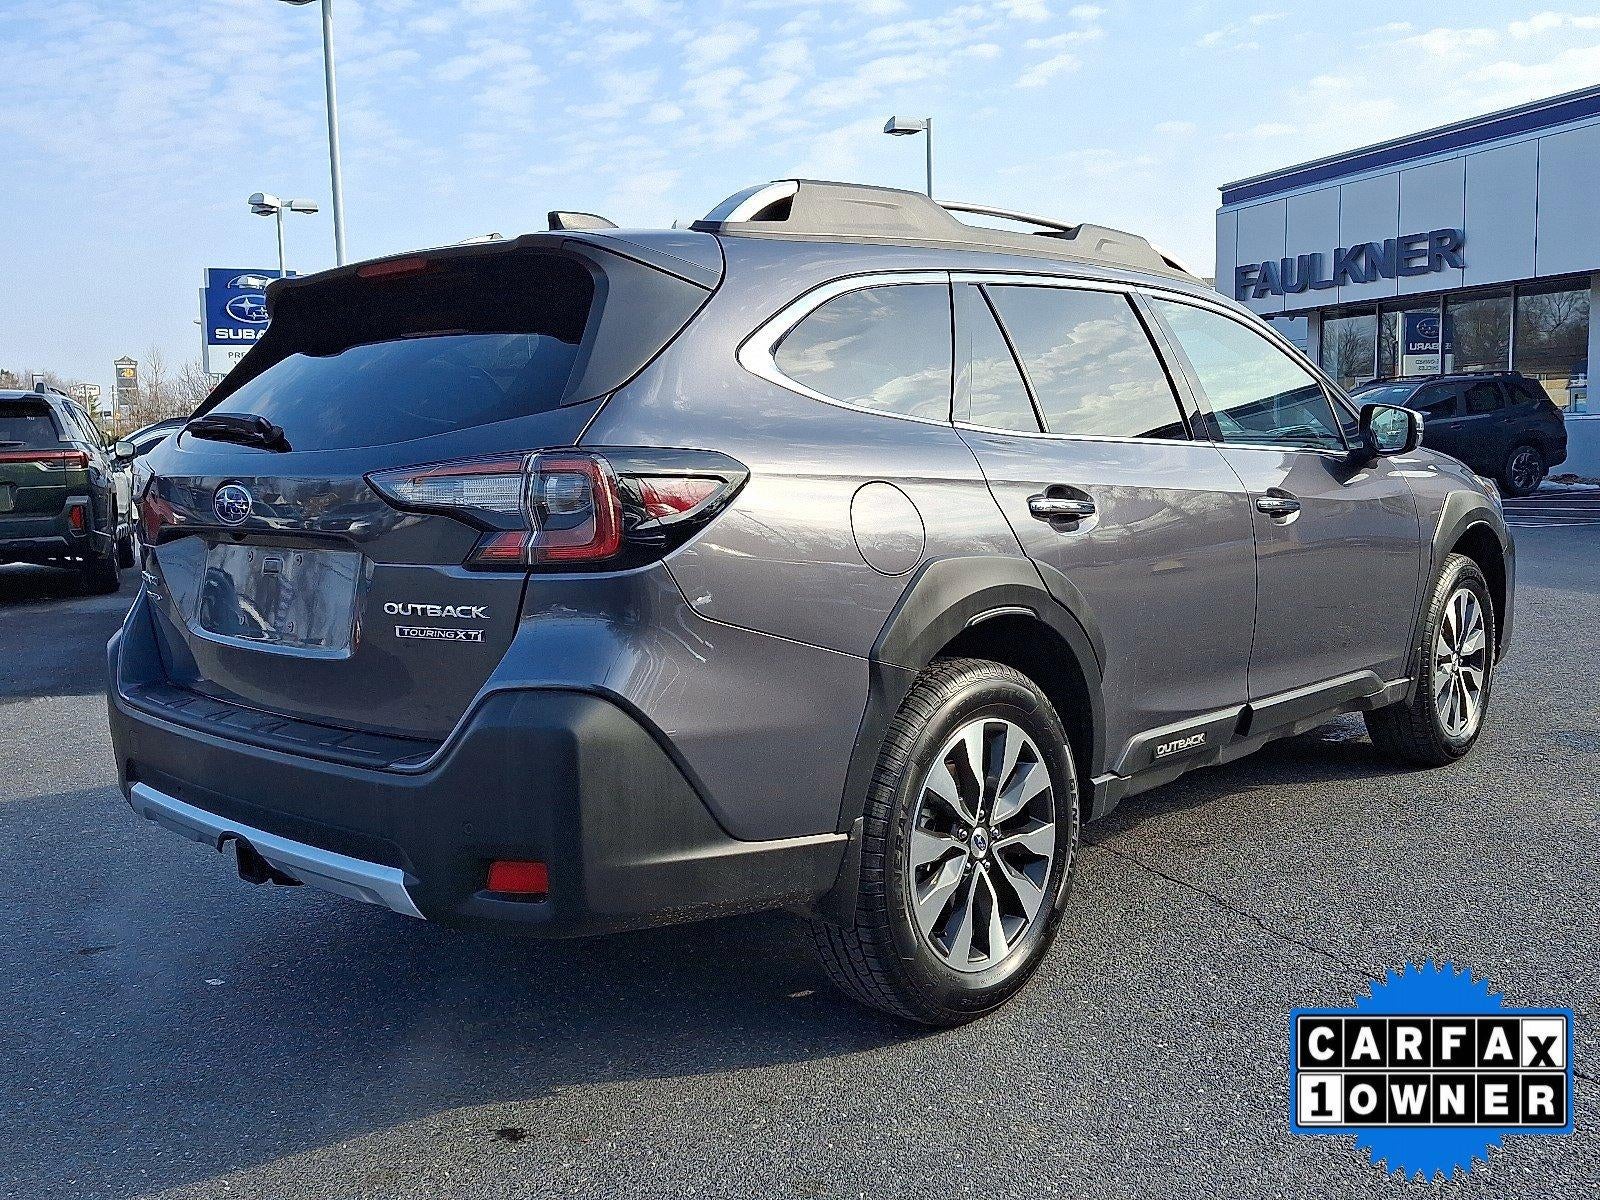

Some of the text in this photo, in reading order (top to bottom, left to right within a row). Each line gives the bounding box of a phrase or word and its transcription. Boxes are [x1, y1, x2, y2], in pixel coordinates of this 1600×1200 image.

[1233, 228, 1467, 301] FAULKNER
[383, 602, 491, 619] OUTBACK
[1156, 732, 1205, 755] OUTBACK
